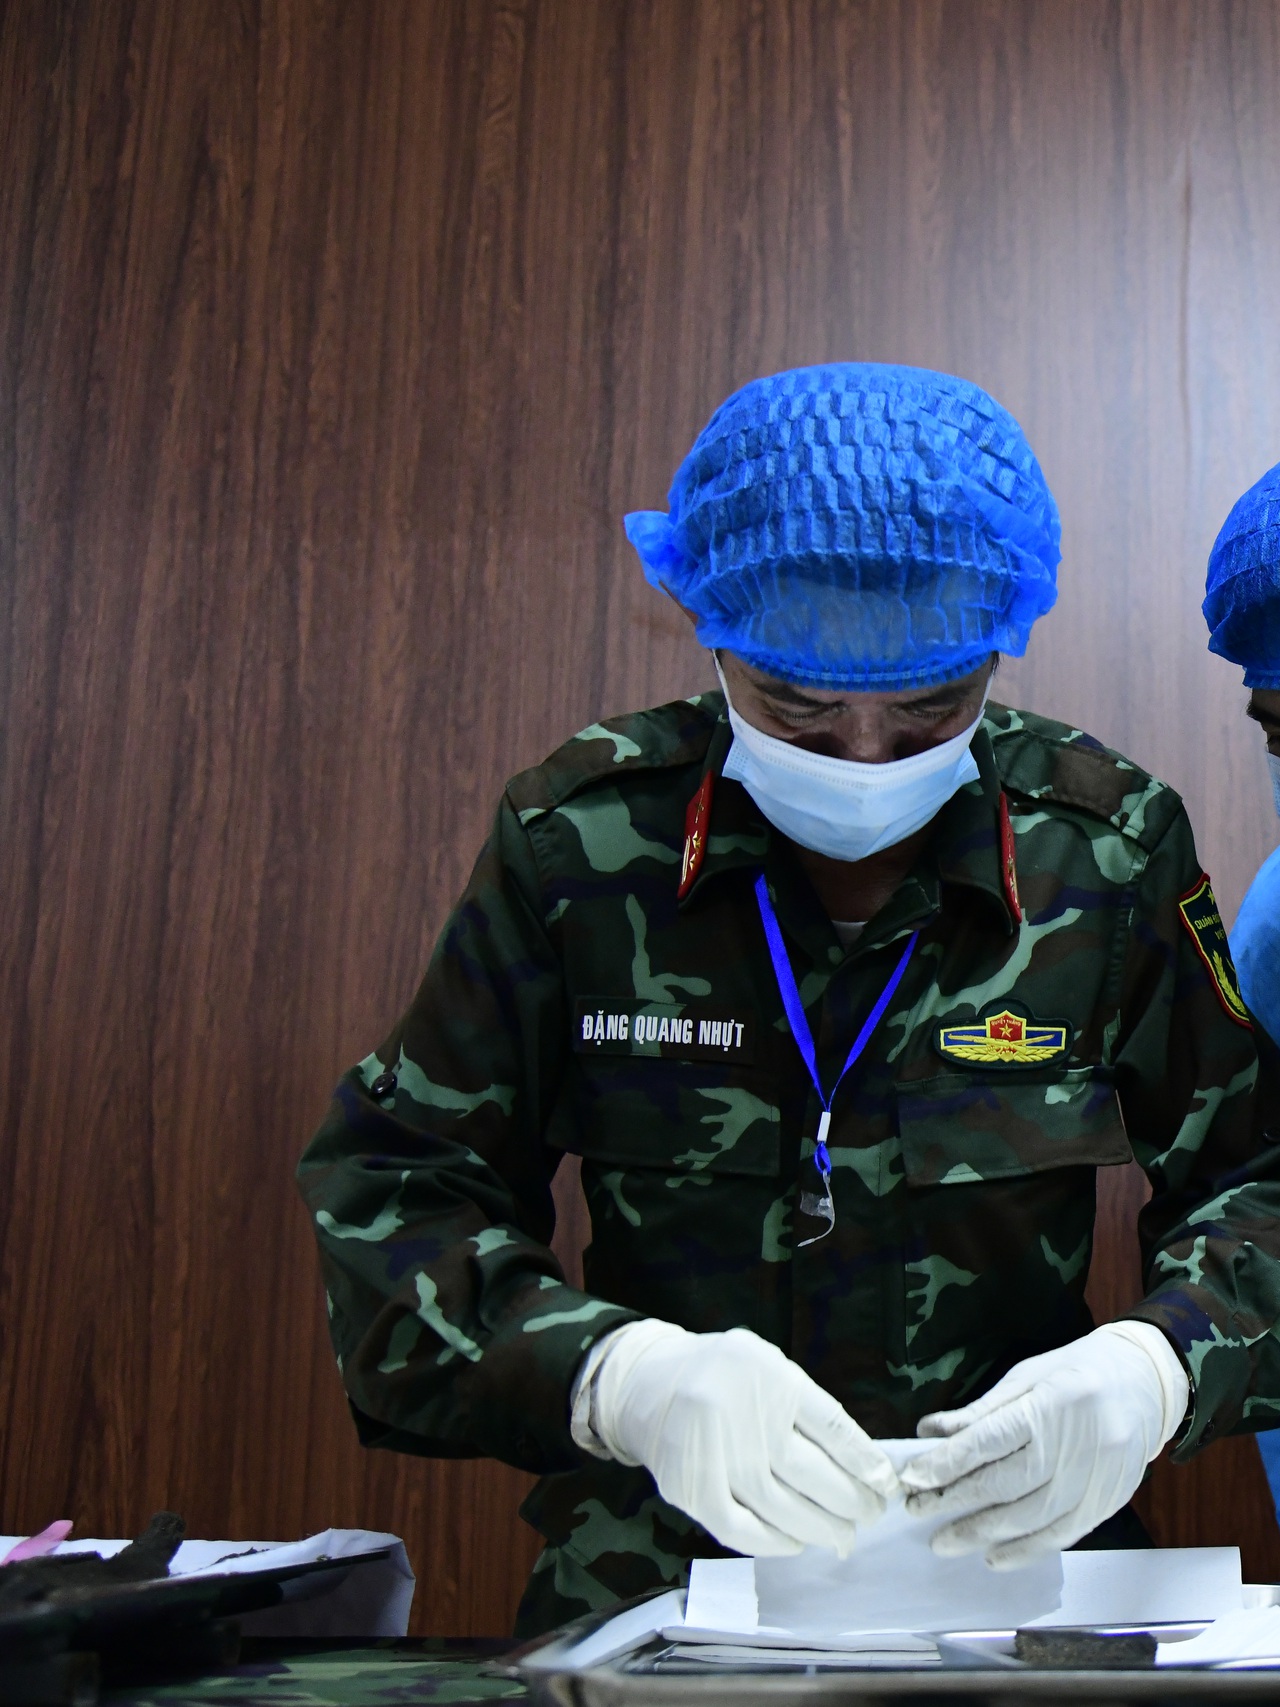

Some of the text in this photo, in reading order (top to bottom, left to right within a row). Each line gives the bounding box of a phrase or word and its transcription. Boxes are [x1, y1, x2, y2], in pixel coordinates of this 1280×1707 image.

[582, 1010, 744, 1051] ĐẶNG QUANG NHỰT
